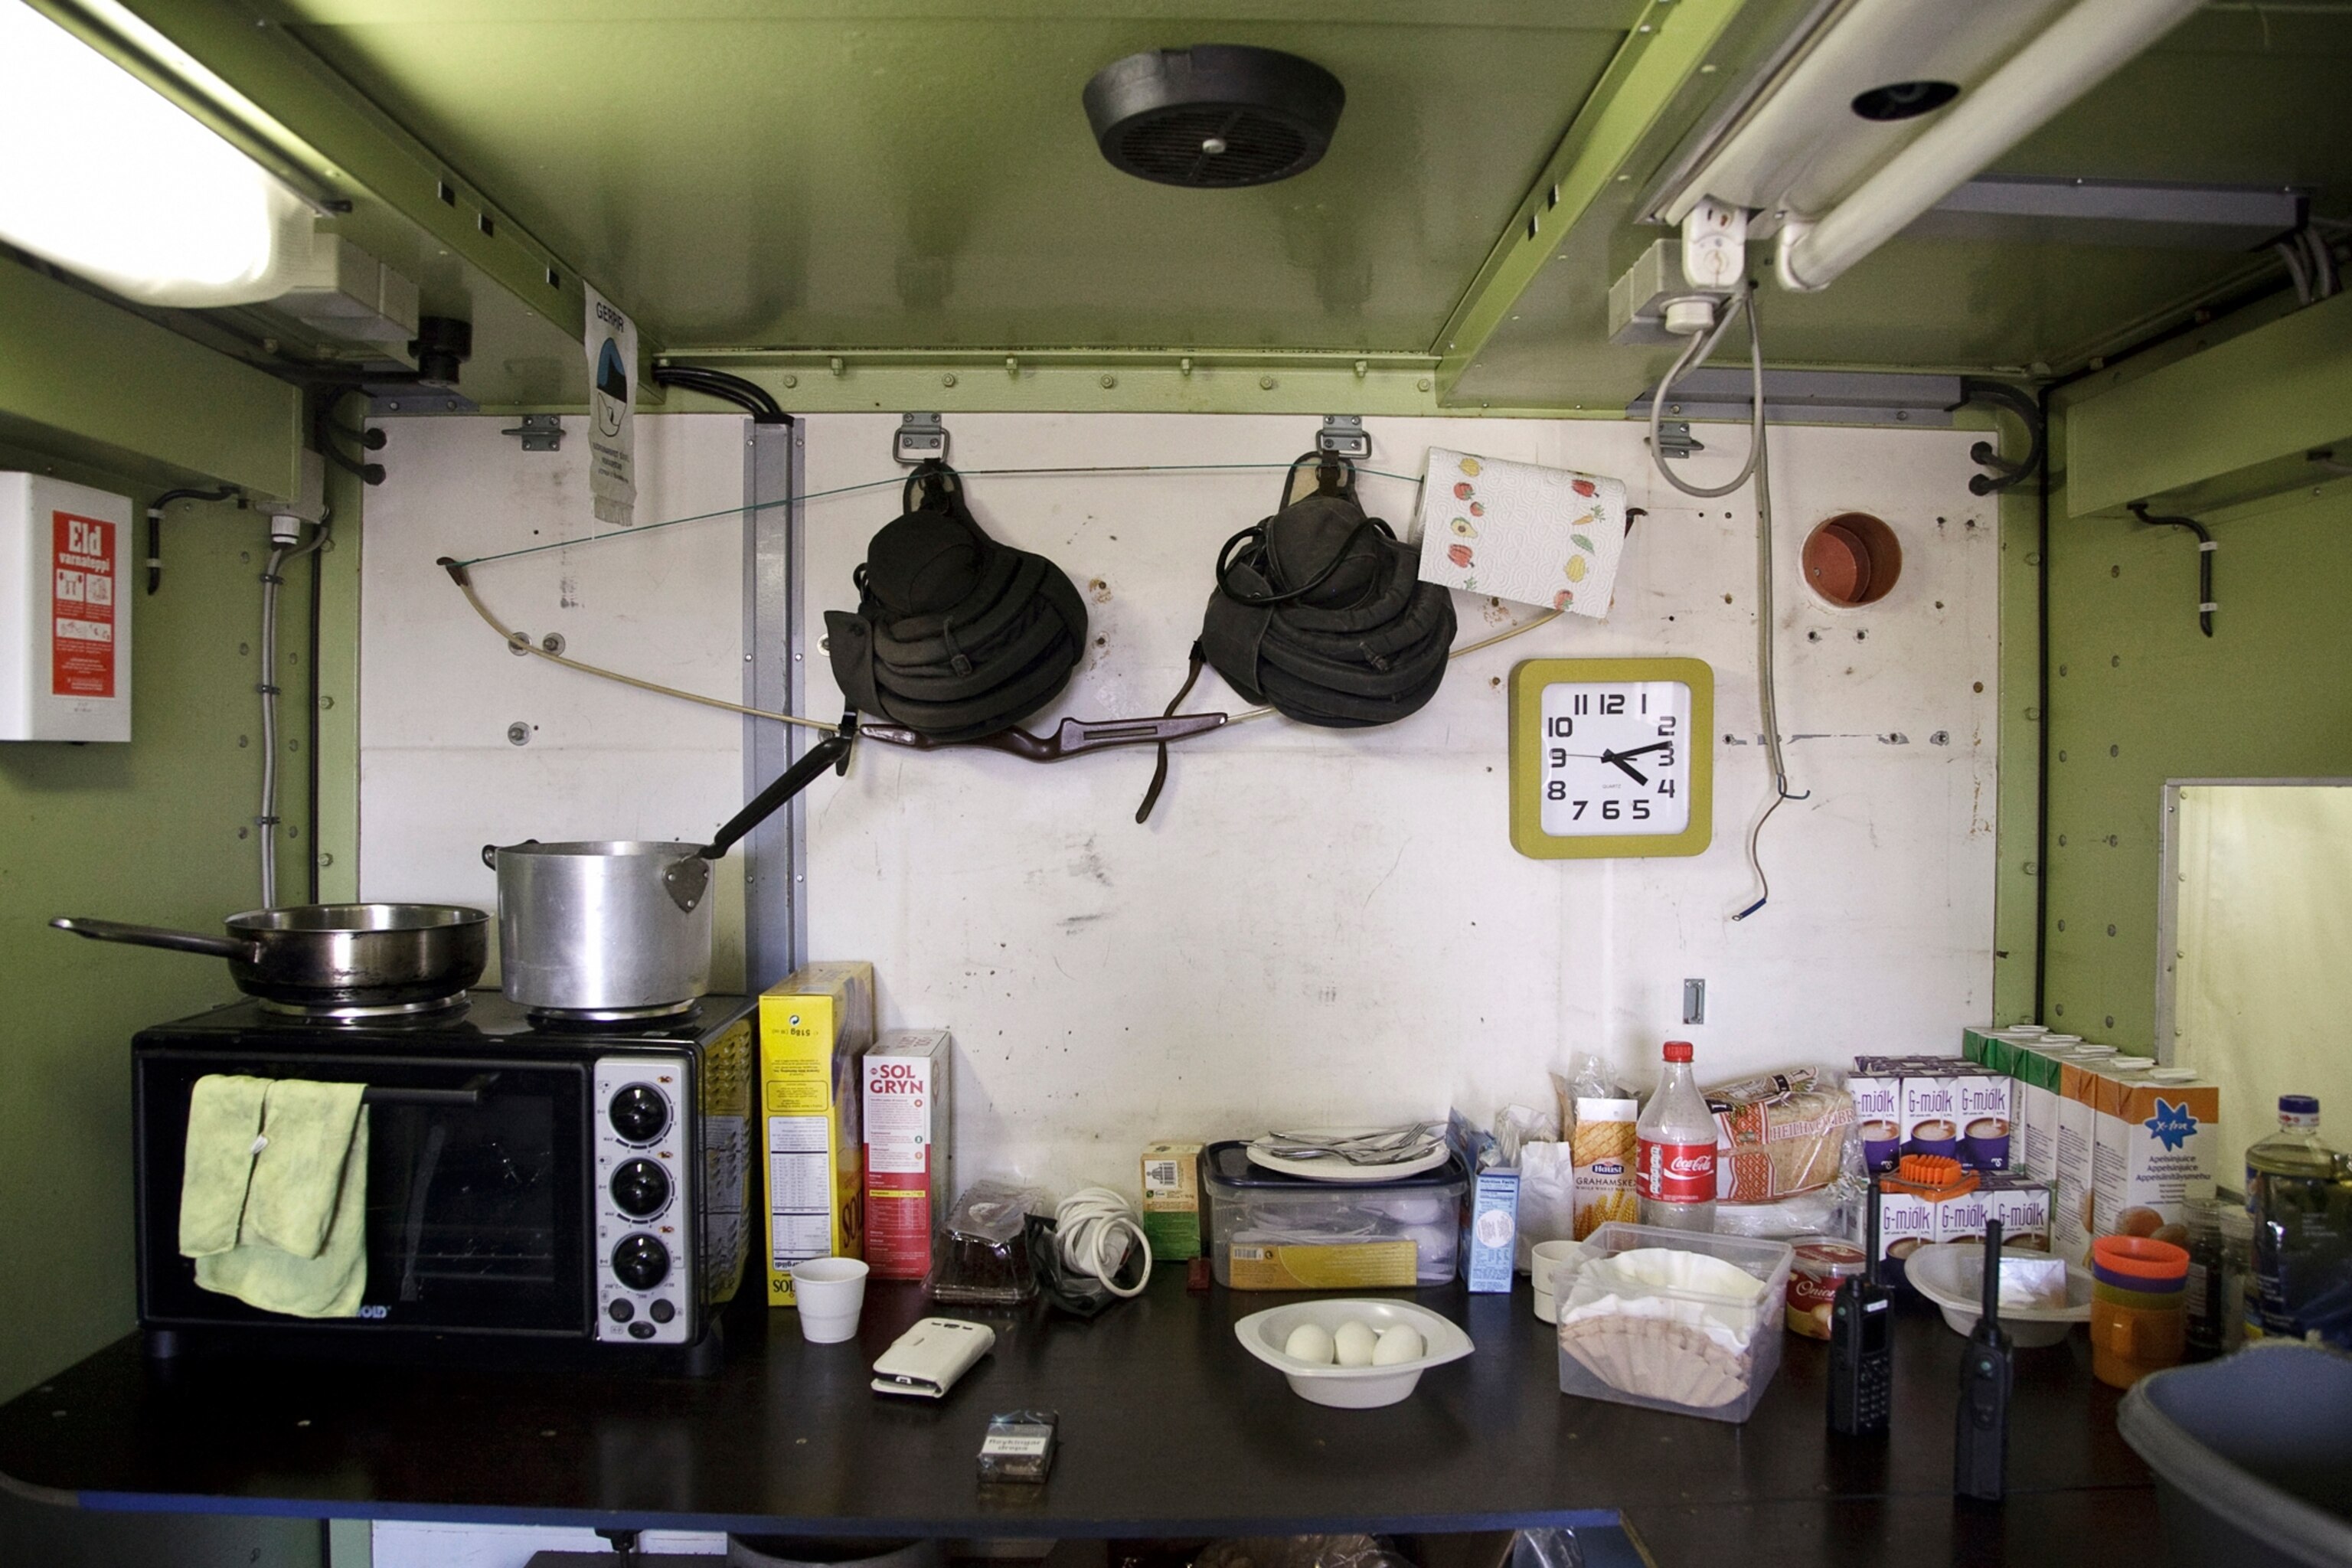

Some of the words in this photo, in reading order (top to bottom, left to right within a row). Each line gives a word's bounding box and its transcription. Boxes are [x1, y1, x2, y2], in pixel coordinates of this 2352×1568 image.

[68, 520, 102, 557] Eld
[1574, 694, 1588, 715] 11
[1600, 694, 1625, 715] 12
[1642, 693, 1646, 714] 1
[1547, 717, 1573, 737] 10
[1658, 716, 1677, 737] 2
[1549, 747, 1566, 768] 9
[1658, 746, 1675, 766] 3
[1547, 780, 1566, 800] 8
[1657, 779, 1675, 799] 4
[1572, 800, 1589, 821] 7
[1602, 800, 1621, 820] 6
[1632, 799, 1651, 820] 5
[790, 1027, 811, 1037] 518g
[880, 1063, 916, 1080] SOL
[870, 1080, 924, 1094] GRYN
[1909, 1089, 1953, 1112] G-mjólk
[1962, 1087, 2006, 1111] G-mjólk
[1594, 1165, 1622, 1174] Haust
[1883, 1206, 1931, 1230] G-mjólk
[1942, 1204, 1988, 1228] G-mjólk
[1999, 1203, 2044, 1227] G-mjólk
[775, 1260, 805, 1269] argildi
